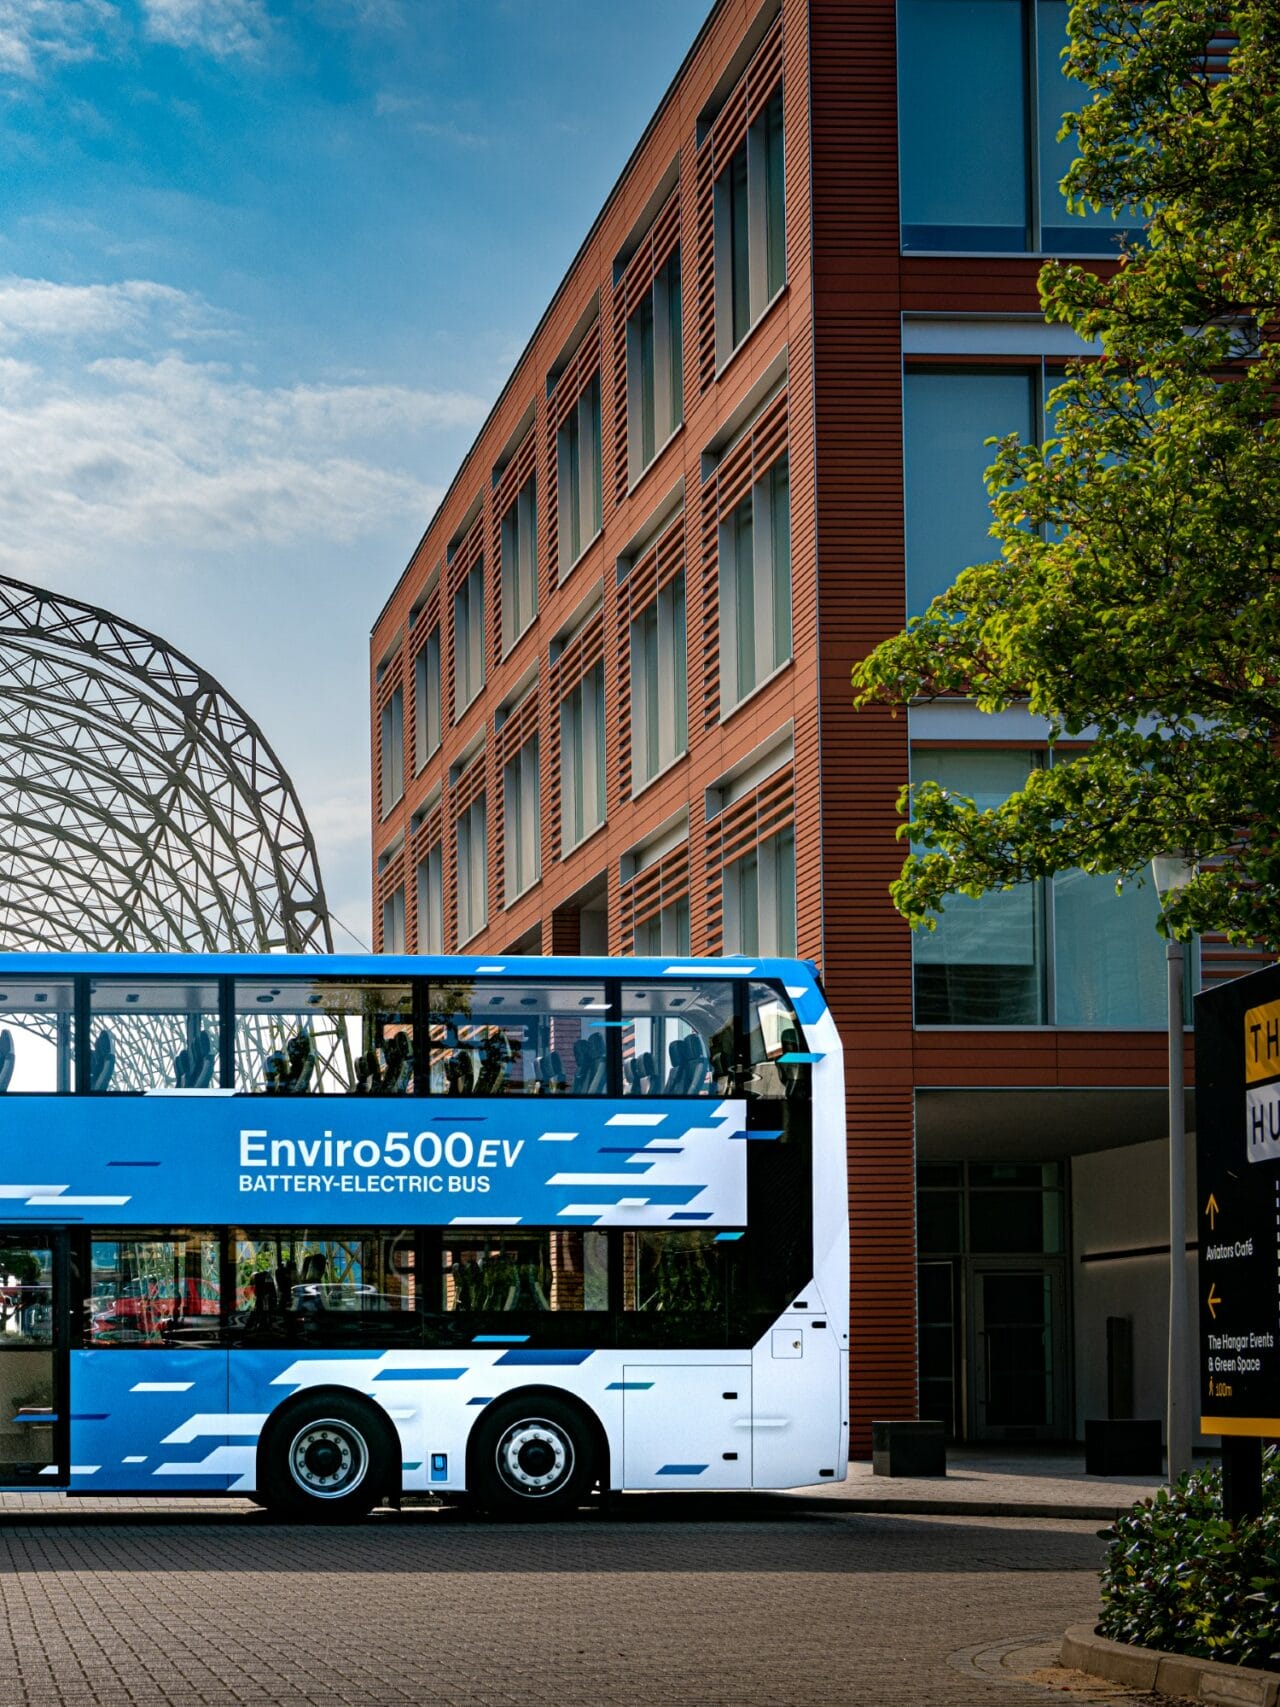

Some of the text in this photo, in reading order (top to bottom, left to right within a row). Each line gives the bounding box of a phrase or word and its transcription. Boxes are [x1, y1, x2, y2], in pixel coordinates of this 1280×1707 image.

[239, 1175, 491, 1192] BATTERY-ELECTRIC BUS
[1206, 1237, 1253, 1261] Aviators Café
[1208, 1332, 1274, 1352] The Hangar Events
[1208, 1355, 1260, 1375] & Green Space
[1215, 1382, 1232, 1396] 100m
